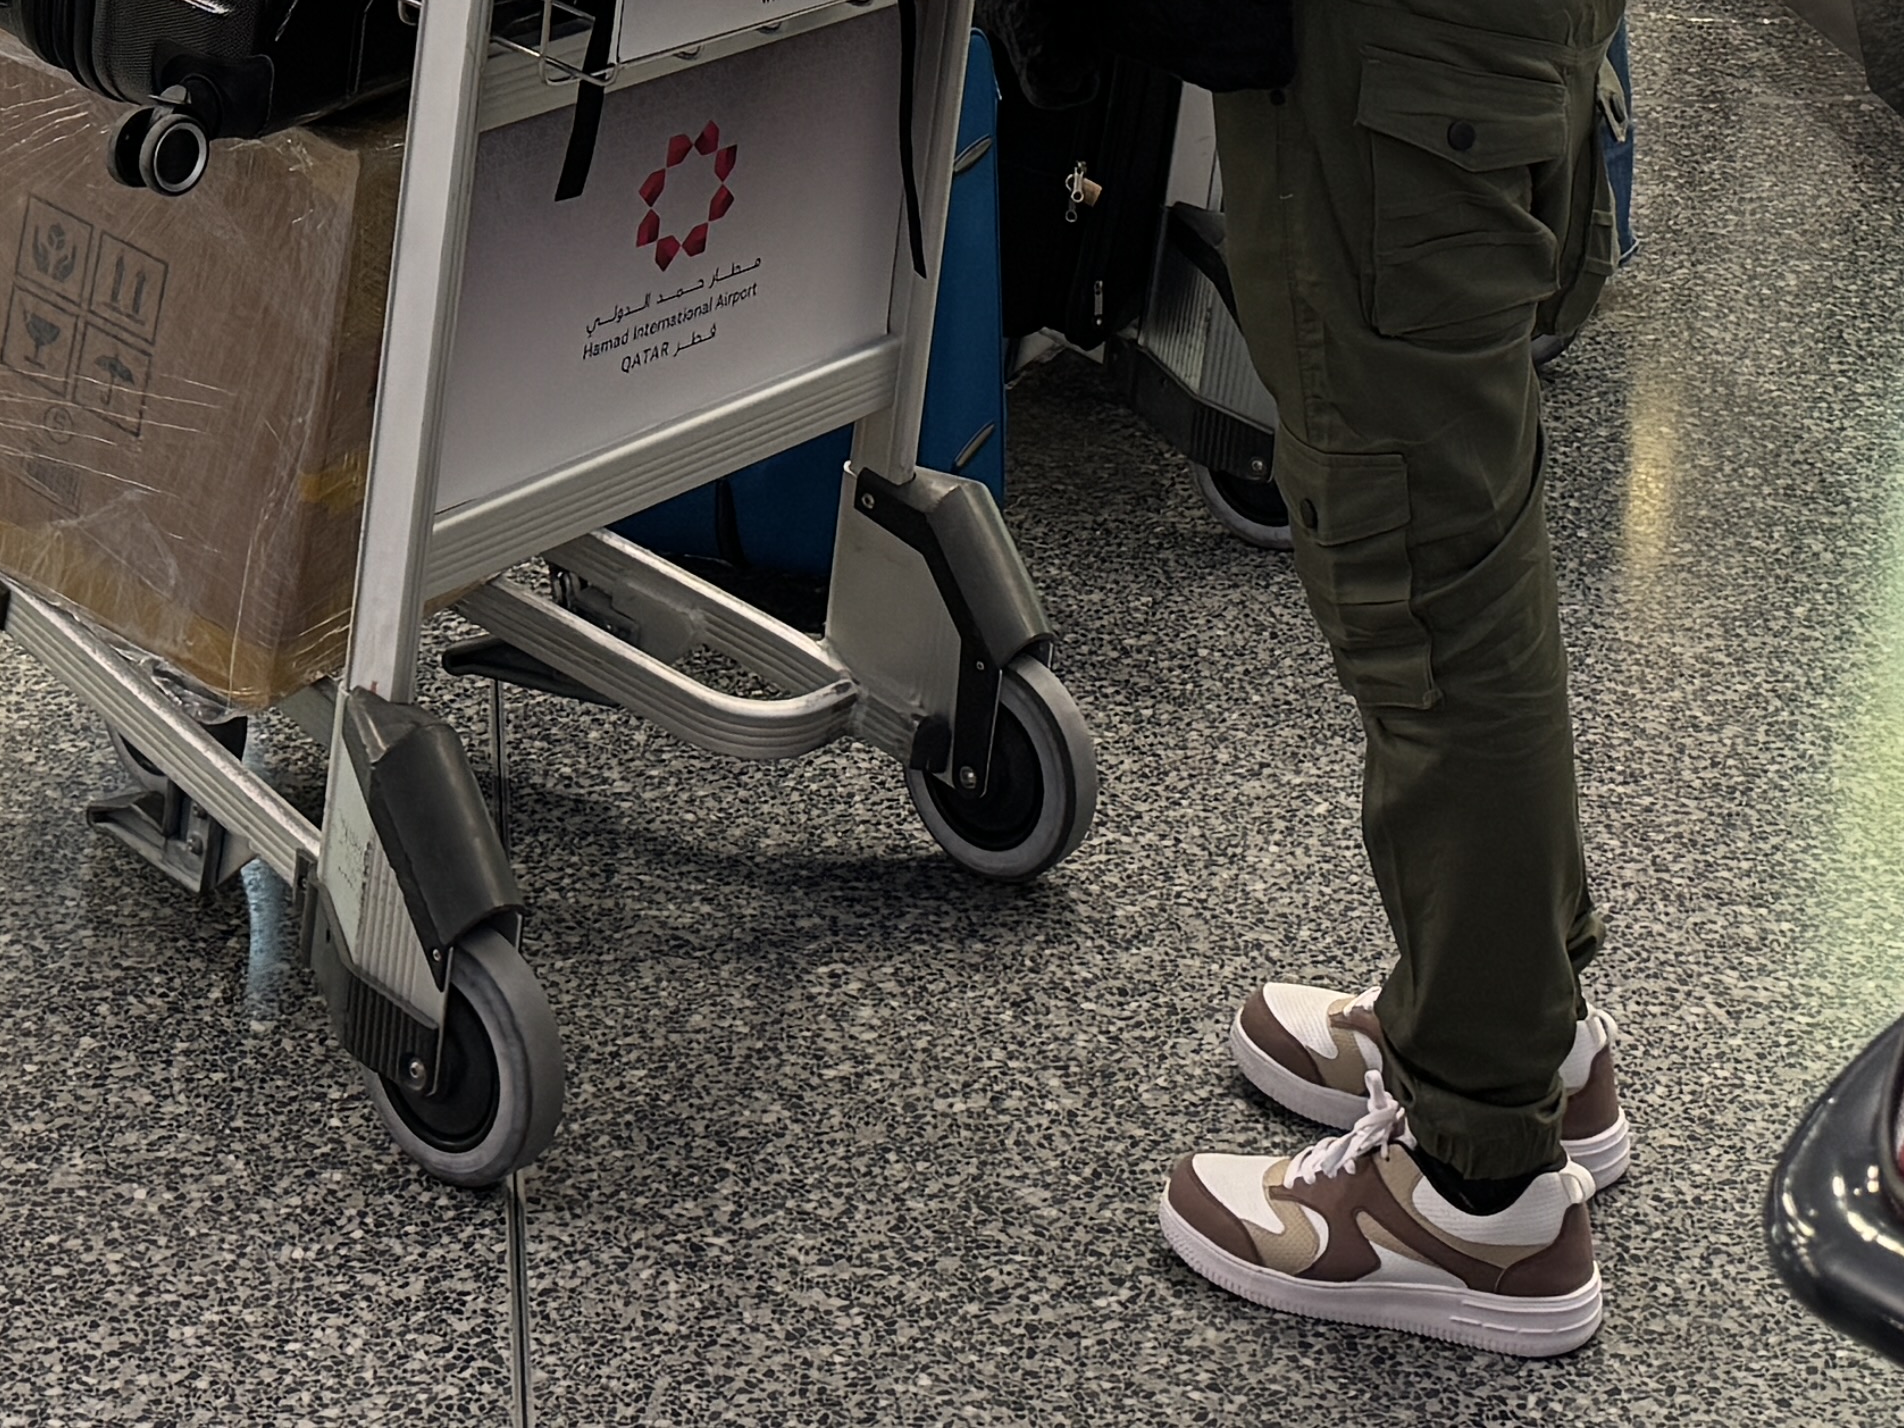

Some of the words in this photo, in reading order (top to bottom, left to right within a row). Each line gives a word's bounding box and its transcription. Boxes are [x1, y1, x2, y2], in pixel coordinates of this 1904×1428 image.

[708, 257, 762, 289] مطار
[656, 278, 705, 305] حمد
[582, 327, 629, 361] Hamad
[632, 297, 713, 341] International
[715, 282, 758, 310] Airport
[585, 292, 652, 338] الدولي
[673, 322, 717, 357] قطر
[620, 341, 669, 374] QATAR
